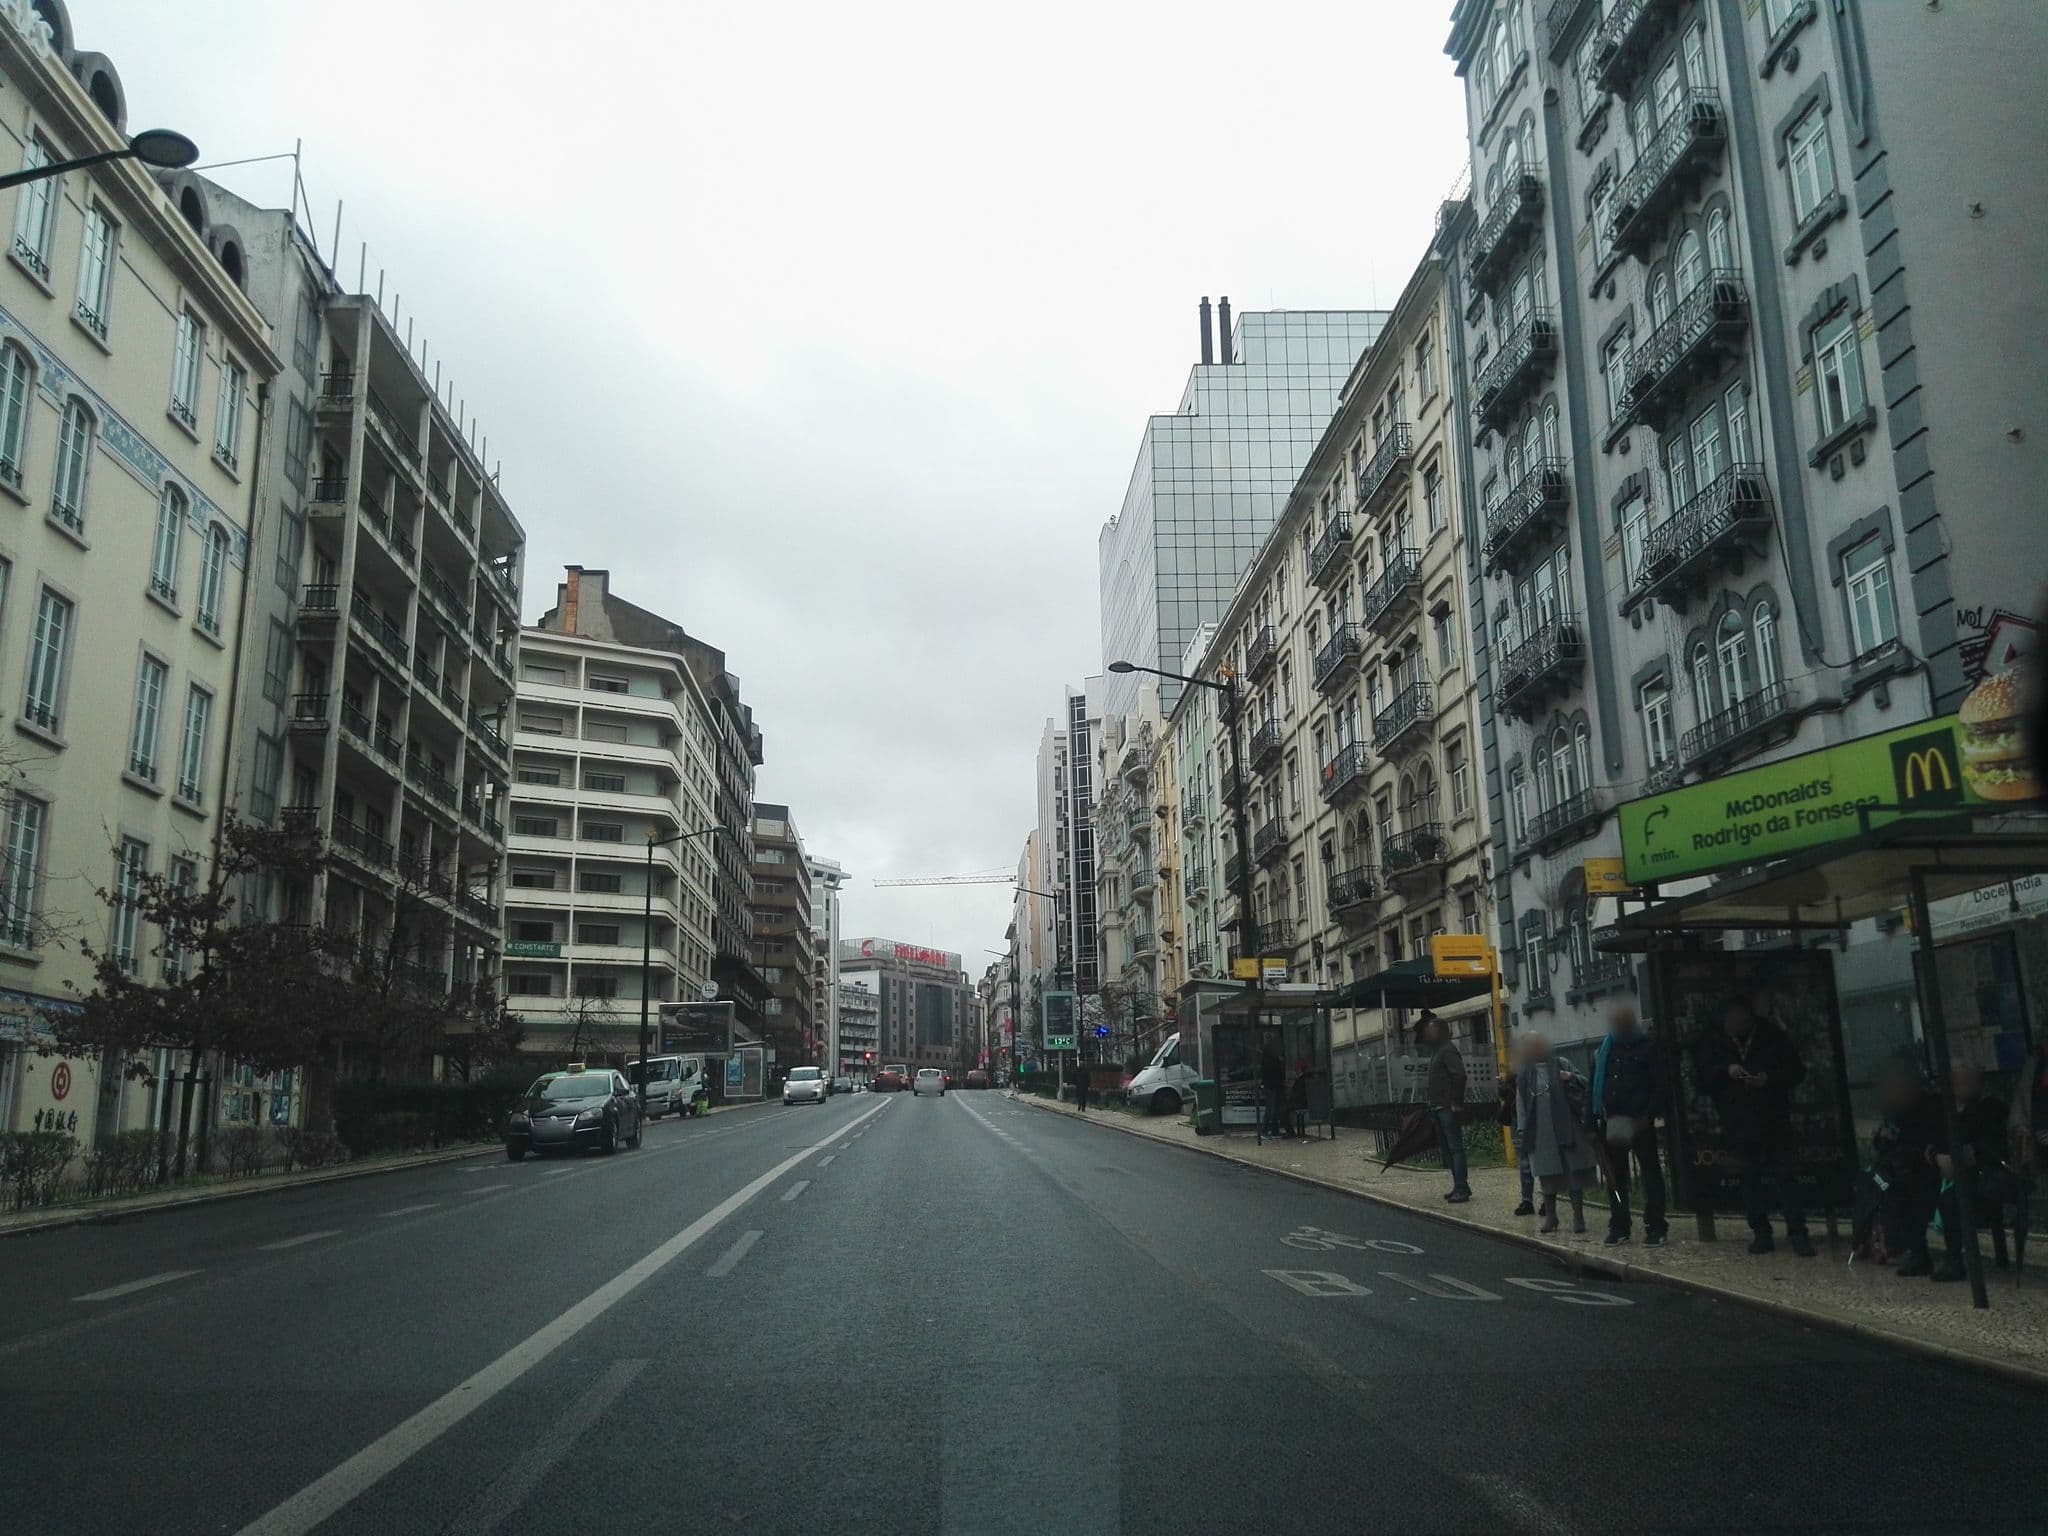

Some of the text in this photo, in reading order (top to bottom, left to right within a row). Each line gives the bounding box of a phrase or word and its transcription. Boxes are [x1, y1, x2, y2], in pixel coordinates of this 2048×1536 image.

[1726, 777, 1832, 819] McDonald's
[1692, 823, 1762, 850] Rodrigo
[1766, 815, 1790, 832] da
[1651, 848, 1680, 864] min.
[1973, 875, 2042, 903] Docelndia
[1260, 1269, 1636, 1305] BUS
